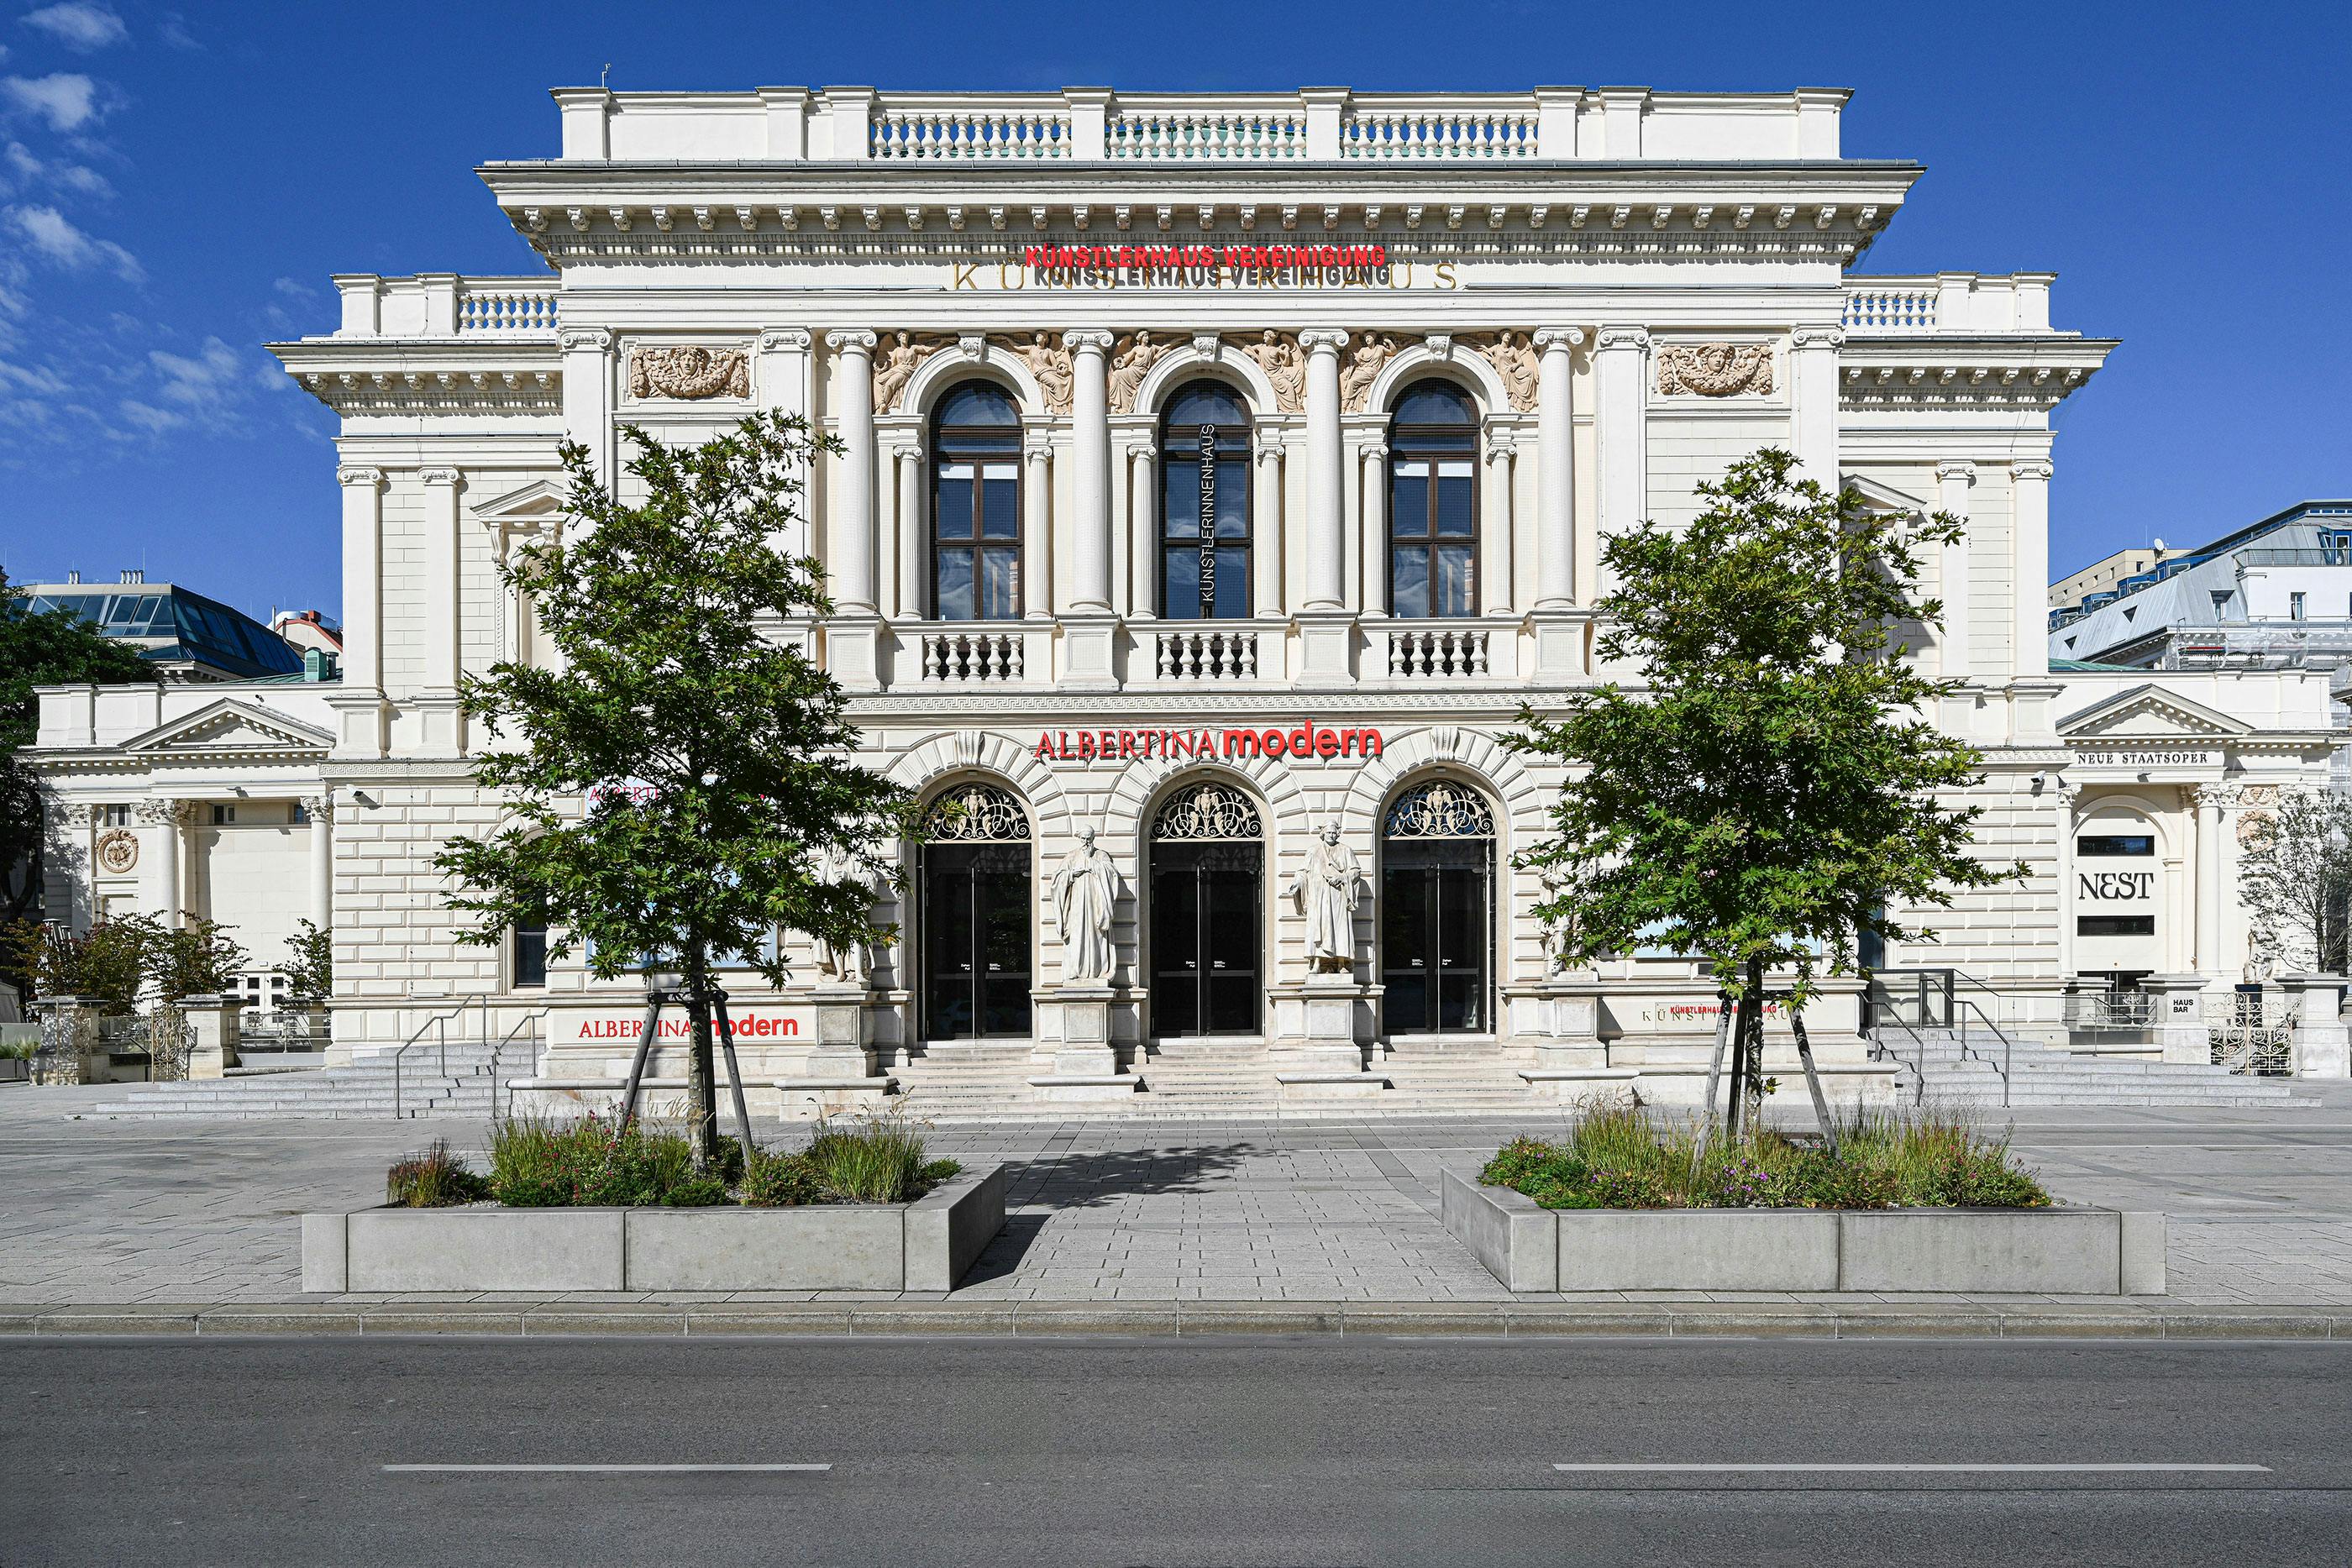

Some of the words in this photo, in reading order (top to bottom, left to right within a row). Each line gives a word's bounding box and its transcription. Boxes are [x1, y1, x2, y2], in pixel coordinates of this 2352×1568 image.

[1026, 243, 1215, 268] KÜNSTLERHAUS
[1223, 245, 1385, 268] VEREINIGUNG
[1200, 423, 1215, 602] KÜNSTLERINNENHAUS
[2078, 754, 2113, 764] NEUE
[2122, 753, 2208, 764] STAATSOPER
[2078, 872, 2155, 900] NEST
[1670, 1004, 1724, 1015] KÜNSTLERHAU
[578, 1019, 692, 1038] ALBERINA
